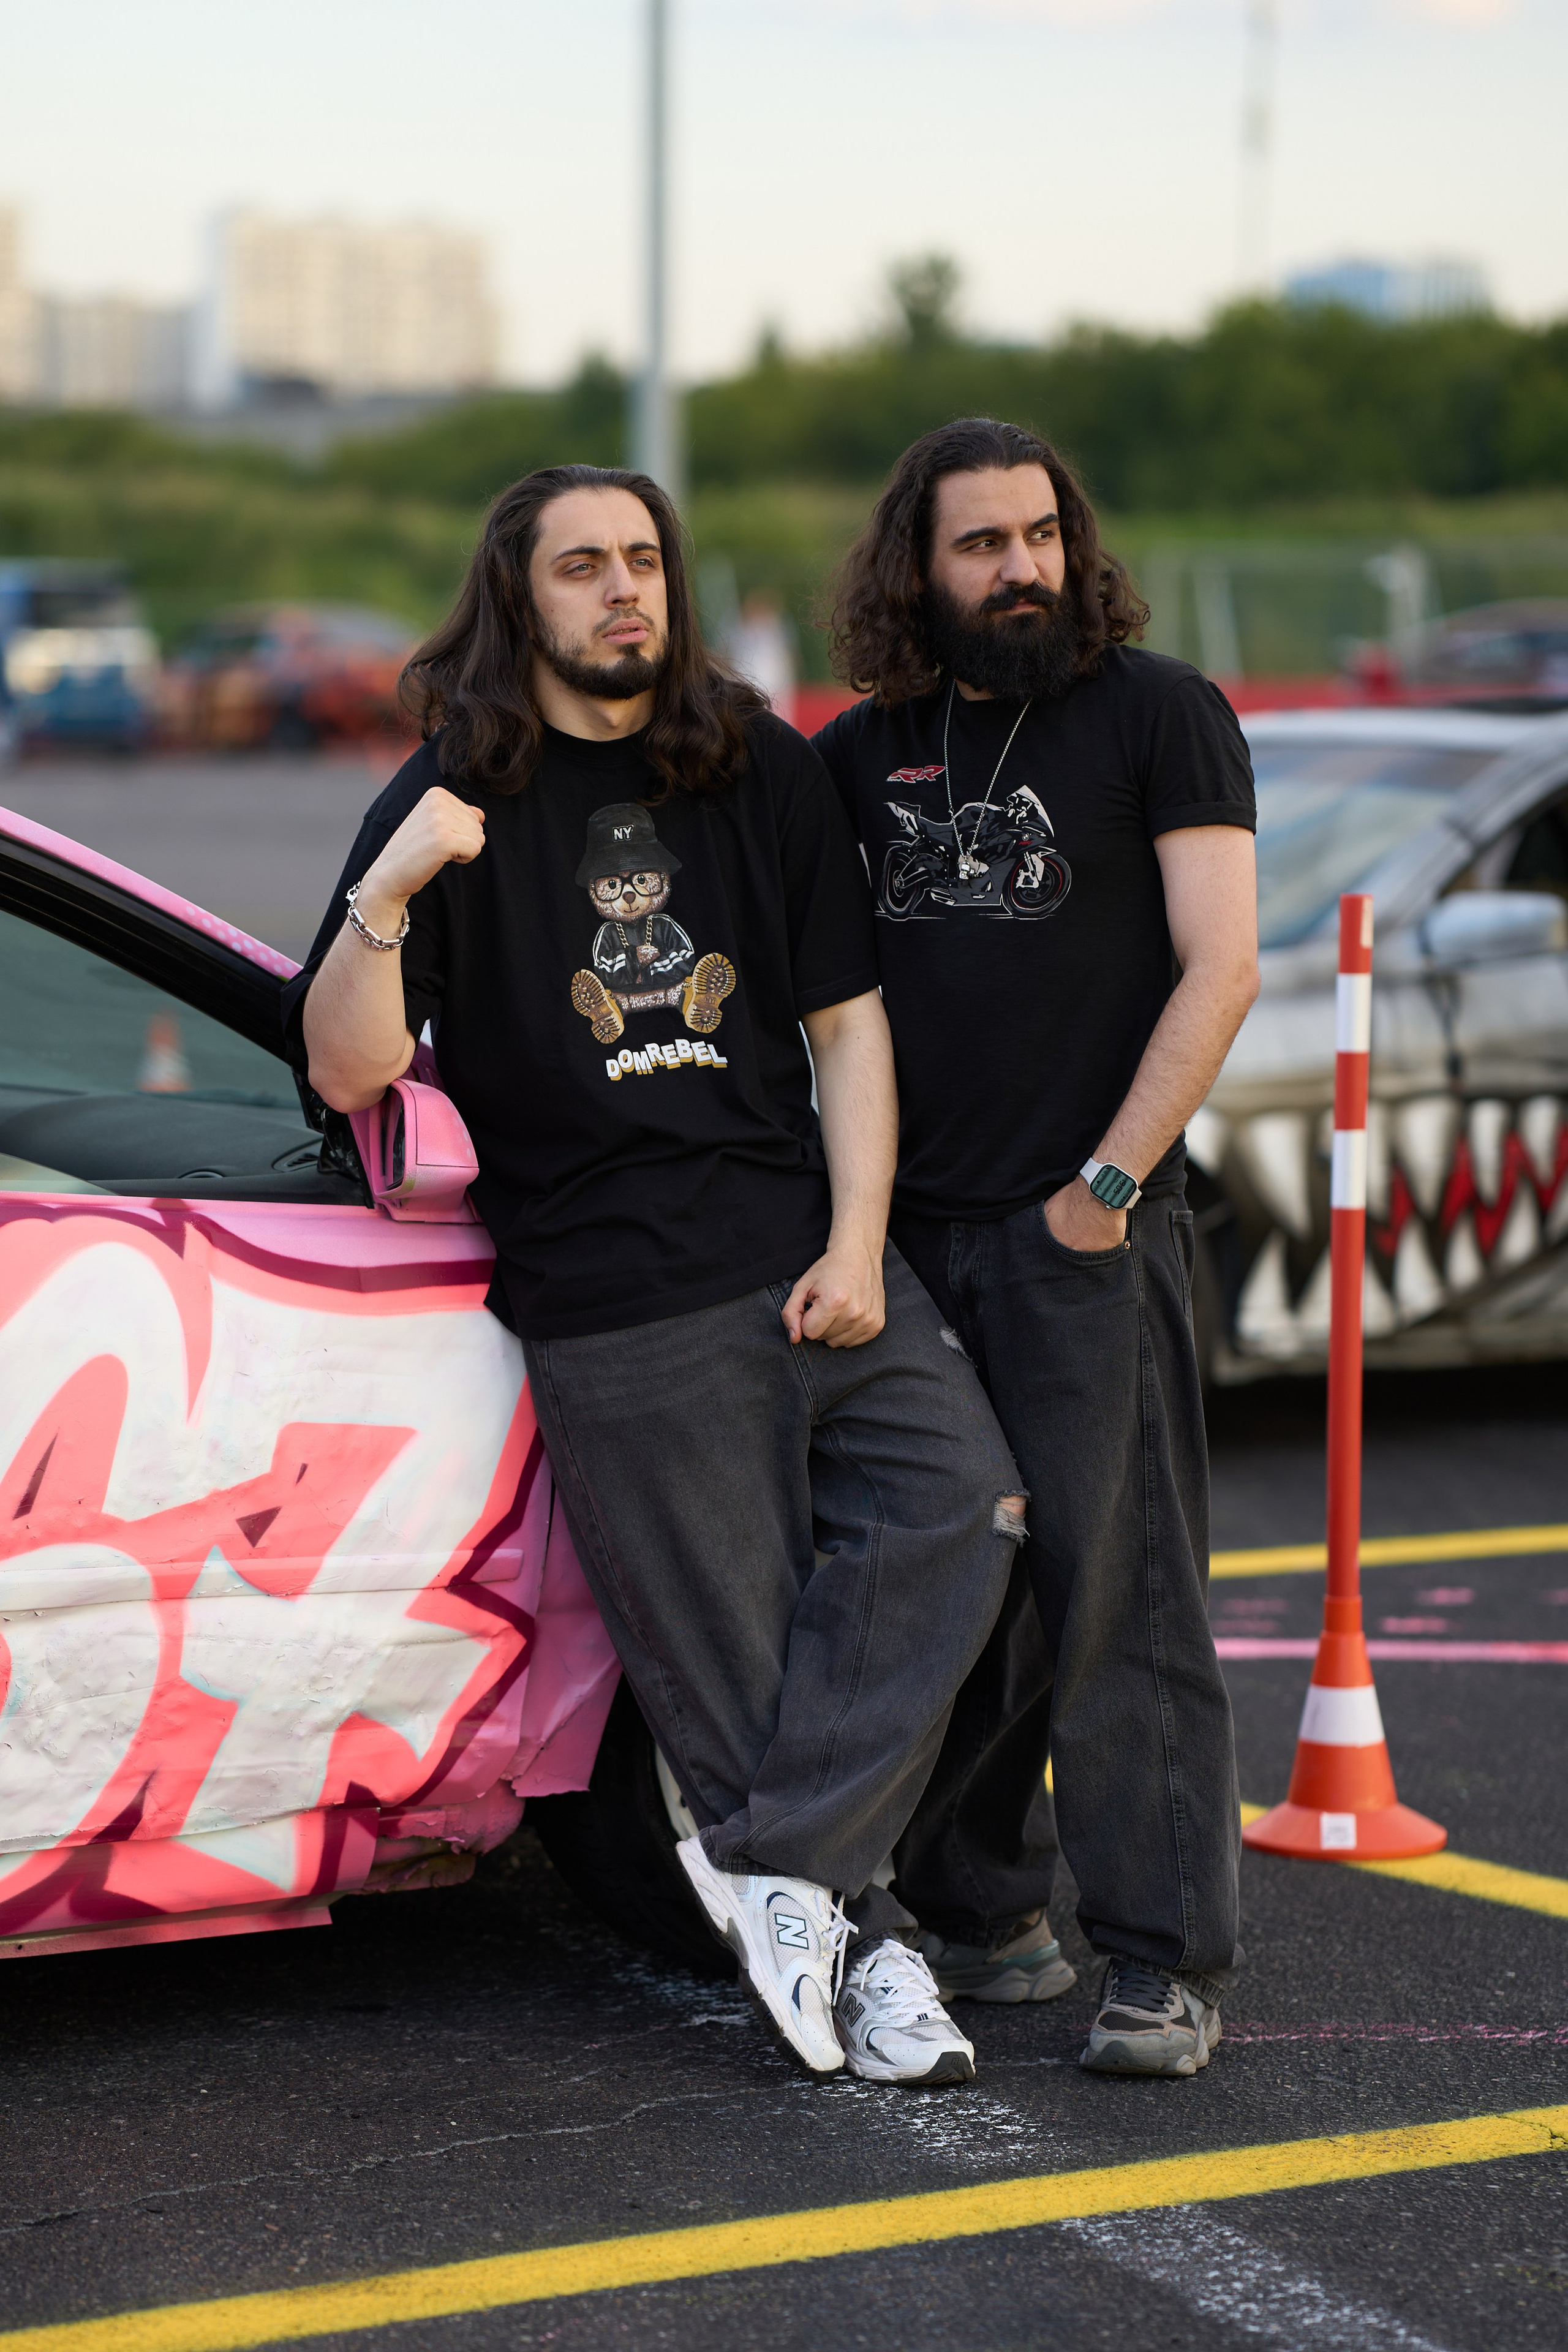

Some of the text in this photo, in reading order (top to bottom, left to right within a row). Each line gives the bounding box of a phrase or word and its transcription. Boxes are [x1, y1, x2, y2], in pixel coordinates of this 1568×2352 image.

[613, 826, 632, 841] NY
[606, 1039, 728, 1080] DOMREBEL
[774, 1912, 809, 1950] N
[842, 1992, 865, 2027] N
